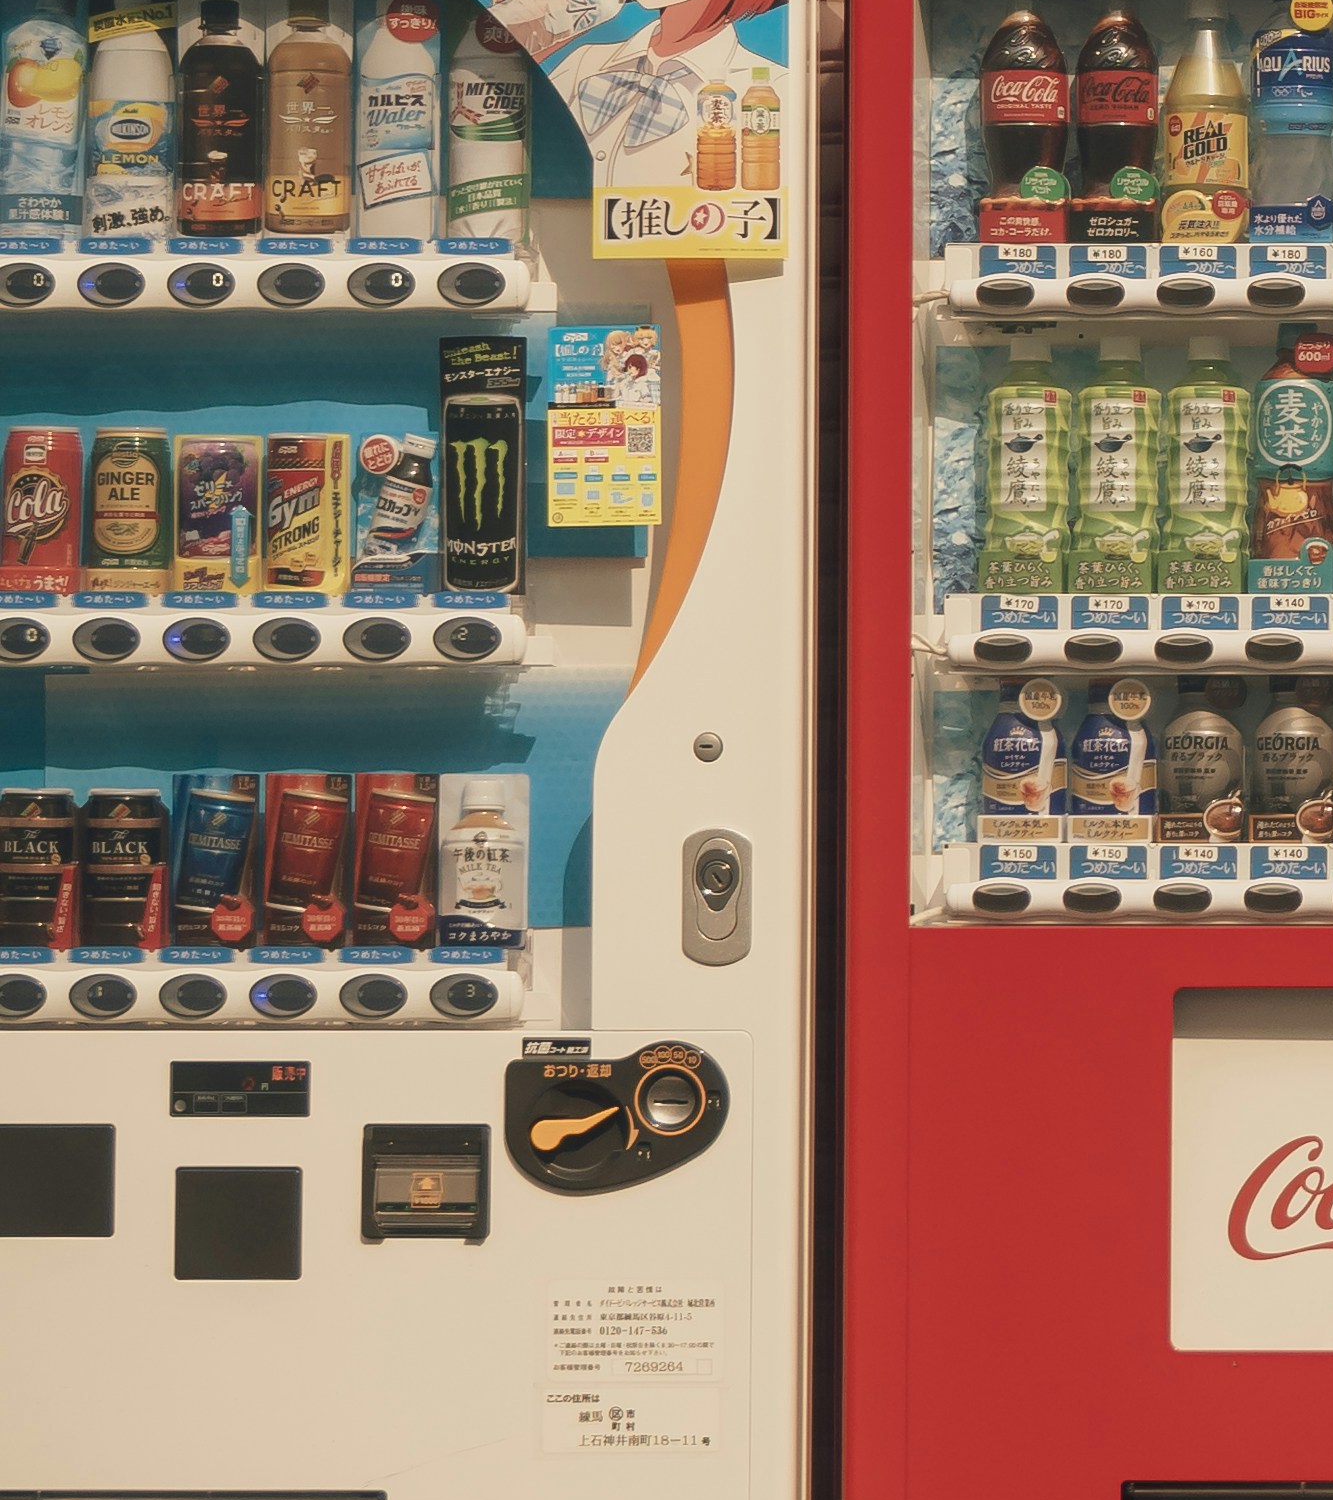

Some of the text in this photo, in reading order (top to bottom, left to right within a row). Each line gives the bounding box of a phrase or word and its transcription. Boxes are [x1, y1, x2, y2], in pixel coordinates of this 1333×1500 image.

[389, 17, 438, 29] すっきり!
[1258, 49, 1331, 81] AQUARIUS
[990, 75, 1060, 105] Coca-Cola
[1082, 75, 1151, 103] Coca-Cola
[368, 94, 426, 107] カルピス
[368, 108, 425, 127] Water
[1183, 120, 1227, 143] REAL
[1183, 137, 1229, 160] GOLD
[182, 182, 255, 201] CRAFT
[272, 180, 341, 198] CRAFT
[605, 198, 780, 239] 【推しの子】
[1002, 247, 1033, 258] ¥180
[1092, 249, 1123, 259] ¥180
[1182, 246, 1214, 258] ¥160
[1272, 249, 1301, 259] ¥180
[444, 367, 520, 382] モンスターエナジー
[1275, 388, 1309, 459] 麦茶
[587, 428, 625, 439] デザイン
[98, 472, 155, 487] GINGER
[1005, 457, 1029, 505] 綾鷹
[108, 487, 140, 501] ALE
[284, 477, 318, 498] ENERGY
[7, 479, 66, 525] Cola
[269, 487, 320, 529] Gym
[1266, 509, 1318, 529] カフェインゼロ
[272, 516, 320, 553] STRONG
[447, 537, 516, 556] MONSTER
[1257, 578, 1322, 589] 後味すっきり
[1005, 598, 1034, 610] ¥170
[1094, 599, 1123, 610] ¥170
[1186, 600, 1215, 610] ¥170
[1275, 597, 1305, 608] ¥140
[4, 841, 59, 854] BLACK
[92, 841, 148, 854] BLACK
[188, 833, 241, 850] DEMITASSE
[281, 832, 335, 850] DEMITASSE
[368, 832, 421, 850] DEMITASSE
[453, 848, 510, 863] 午後の紅茶
[1002, 848, 1032, 858] ¥150
[1092, 848, 1122, 858] ¥150
[458, 863, 502, 874] MILK TEA
[448, 931, 512, 941] コクまろやか
[673, 1051, 683, 1059] 50
[688, 1056, 697, 1064] 10
[271, 1066, 306, 1081] 販売中
[543, 1064, 612, 1078] おつり・返却
[600, 1326, 668, 1335] 0120-147-536
[625, 1361, 683, 1373] 7269264
[547, 1394, 600, 1403] ここの住所は
[579, 1411, 603, 1422] 練馬
